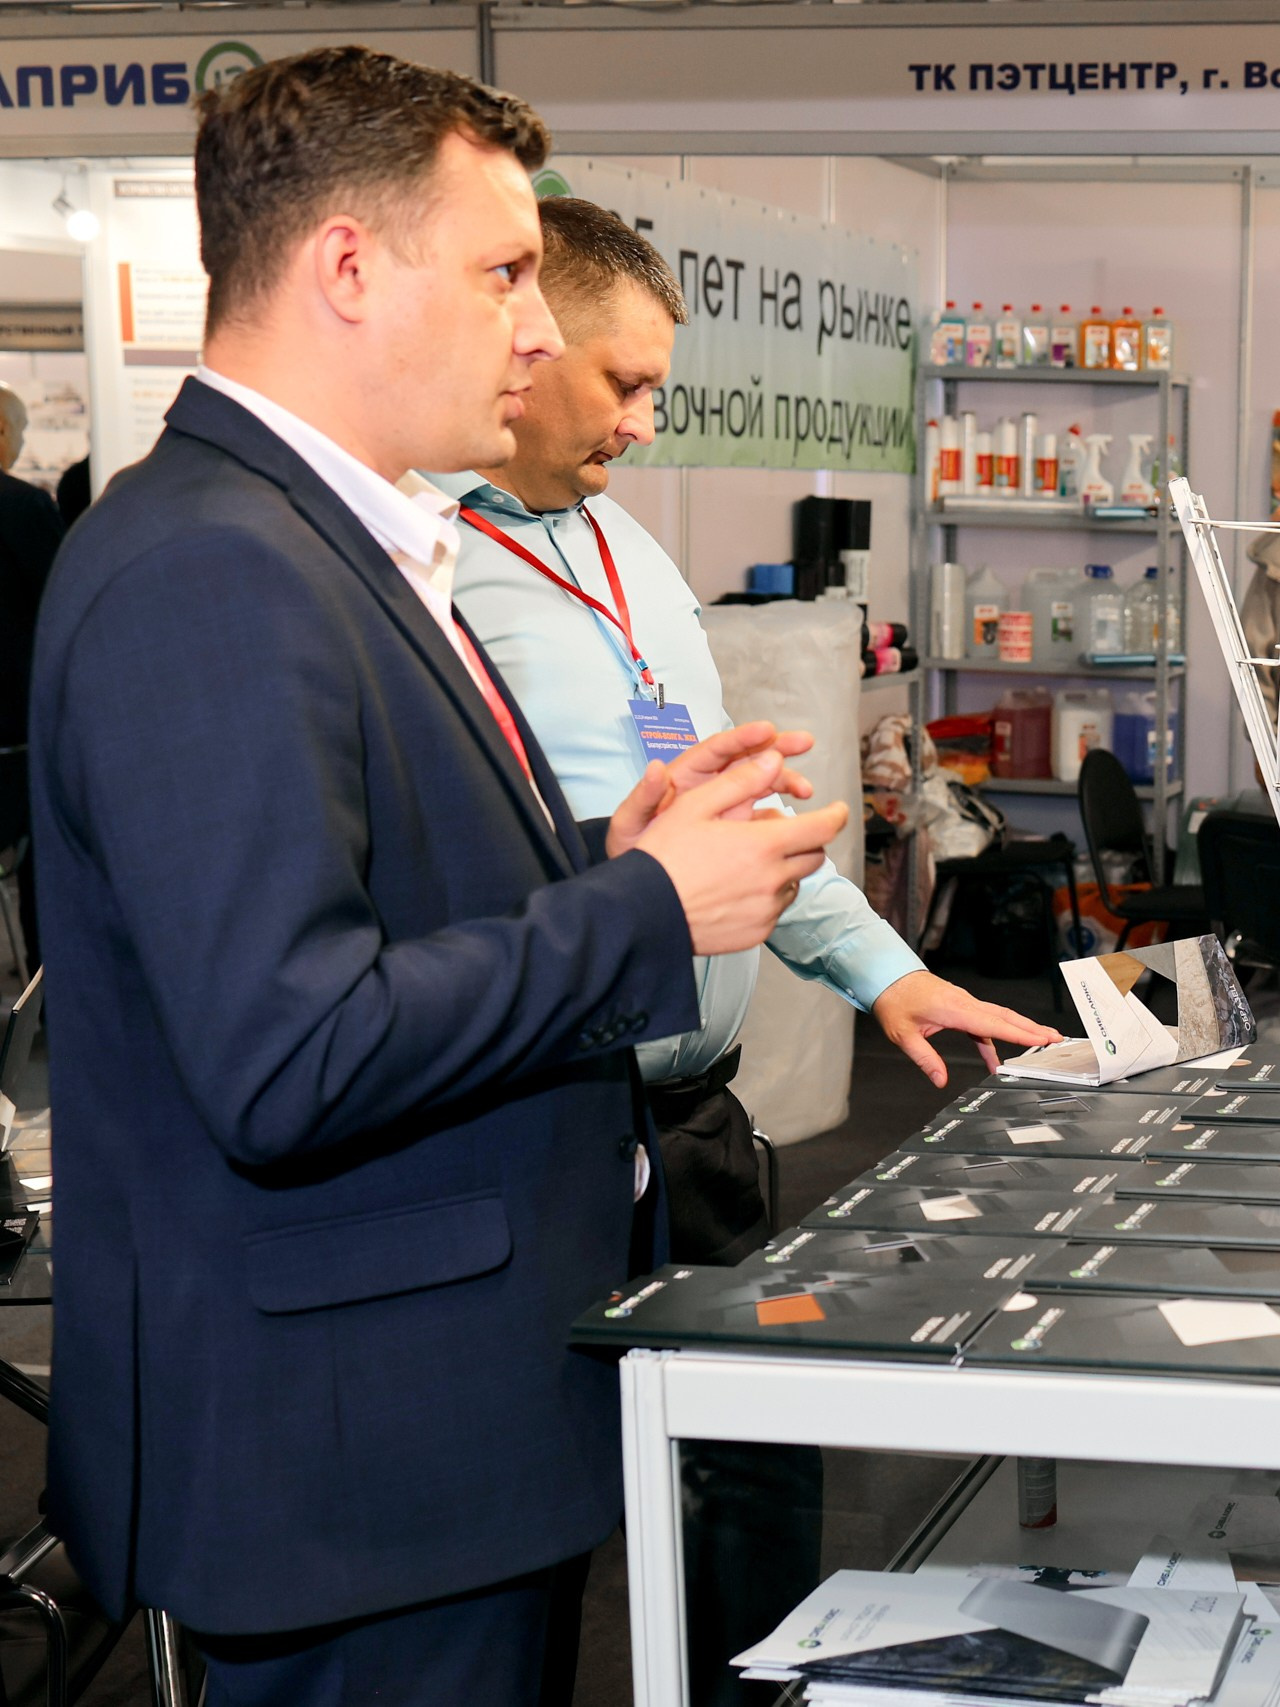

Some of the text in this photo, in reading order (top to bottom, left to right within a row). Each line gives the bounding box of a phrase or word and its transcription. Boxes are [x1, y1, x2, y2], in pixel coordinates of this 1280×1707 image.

[908, 64, 956, 91] ТК
[968, 62, 1188, 95] ПЭТЦЕНТР,
[1202, 68, 1229, 89] г.
[760, 265, 803, 331] на
[817, 278, 912, 356] рынке
[653, 375, 913, 460] вочной продукции
